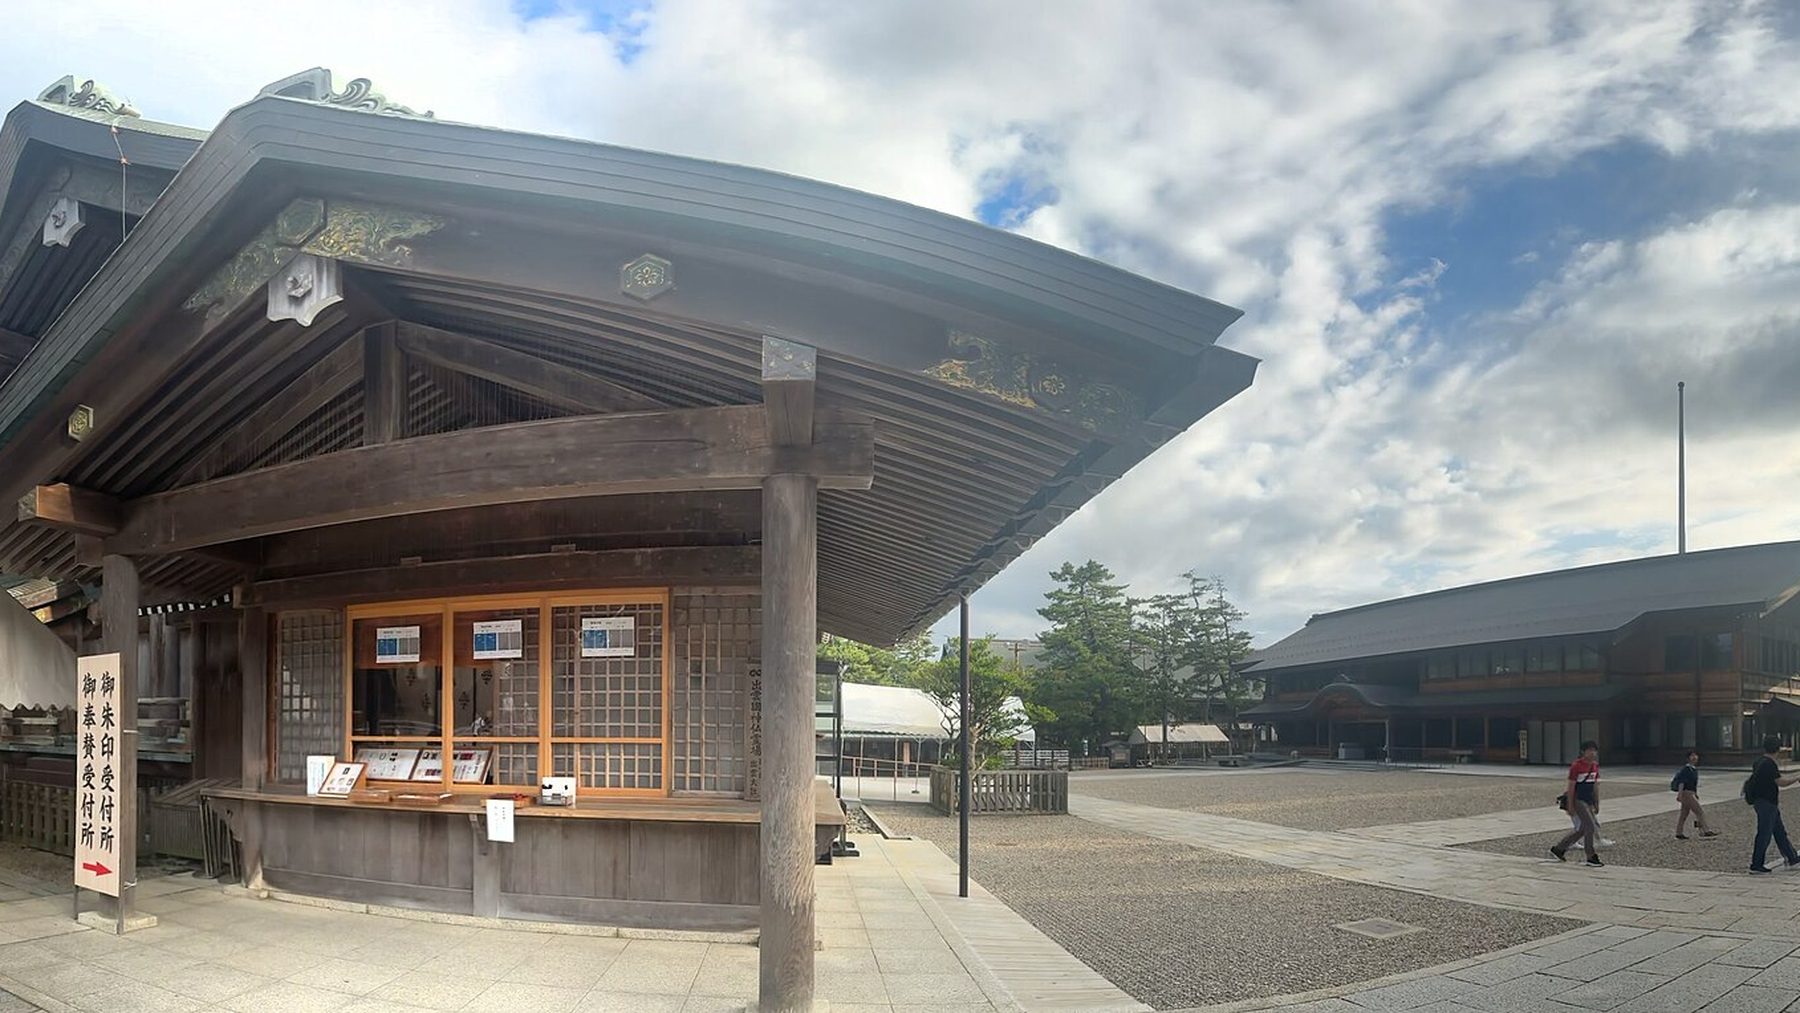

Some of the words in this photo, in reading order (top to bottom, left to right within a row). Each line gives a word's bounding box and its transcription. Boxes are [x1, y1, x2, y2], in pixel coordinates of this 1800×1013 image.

[100, 670, 115, 854] 御朱印受付所
